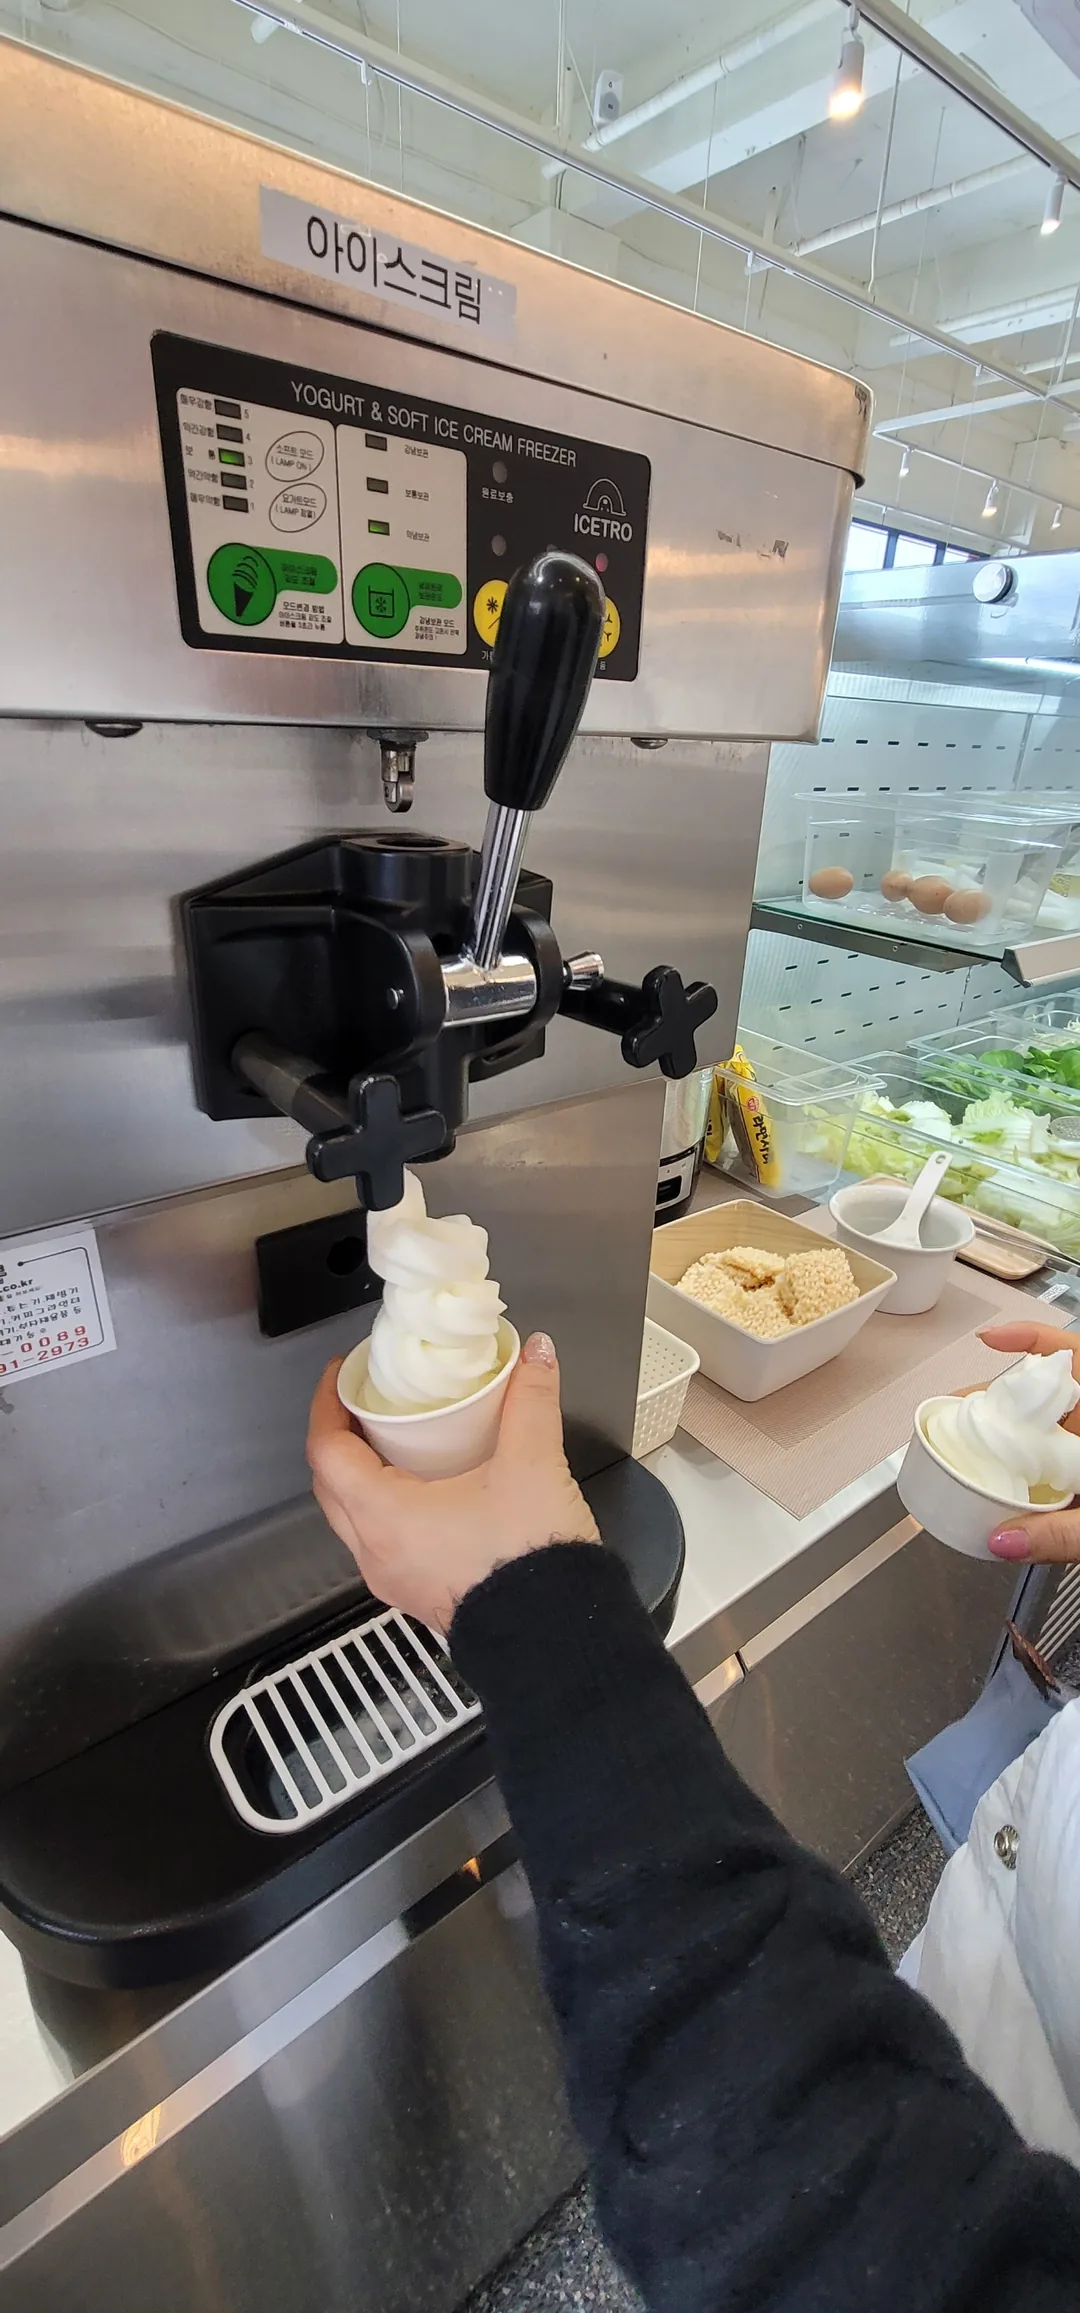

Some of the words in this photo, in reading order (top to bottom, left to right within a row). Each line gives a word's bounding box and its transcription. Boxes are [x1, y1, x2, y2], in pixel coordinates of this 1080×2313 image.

[307, 215, 481, 325] 아이스크림
[244, 409, 250, 419] 5
[291, 380, 365, 417] YOGURT
[371, 401, 383, 422] &
[388, 405, 429, 432] SOFT
[434, 416, 459, 440] ICE
[463, 424, 513, 452] CREAM
[517, 438, 577, 467] FREEZER
[245, 432, 251, 442] 4
[276, 444, 298, 458] 소프트
[299, 448, 314, 460] 모드
[248, 456, 253, 465] 3
[249, 479, 255, 489] 2
[481, 487, 514, 504] 원료보충
[250, 502, 255, 511] 1
[574, 513, 633, 542] ICETRO
